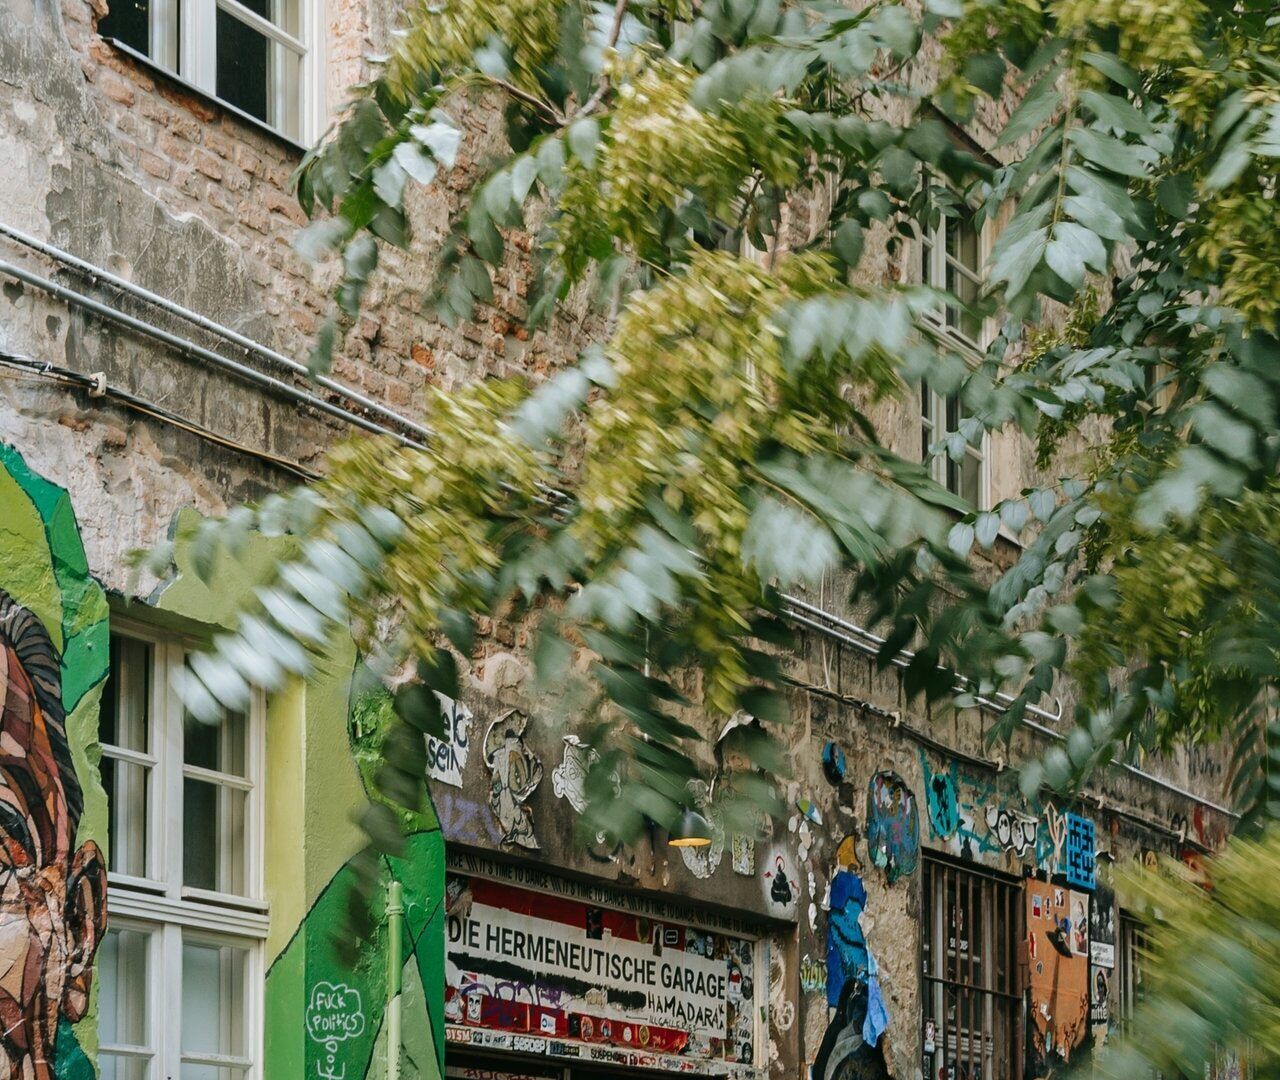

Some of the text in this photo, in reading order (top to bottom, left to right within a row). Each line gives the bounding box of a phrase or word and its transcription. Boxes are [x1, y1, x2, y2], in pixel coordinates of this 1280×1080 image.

[448, 915, 726, 1000] DIE HERMENEUTISCHE GARAGE
